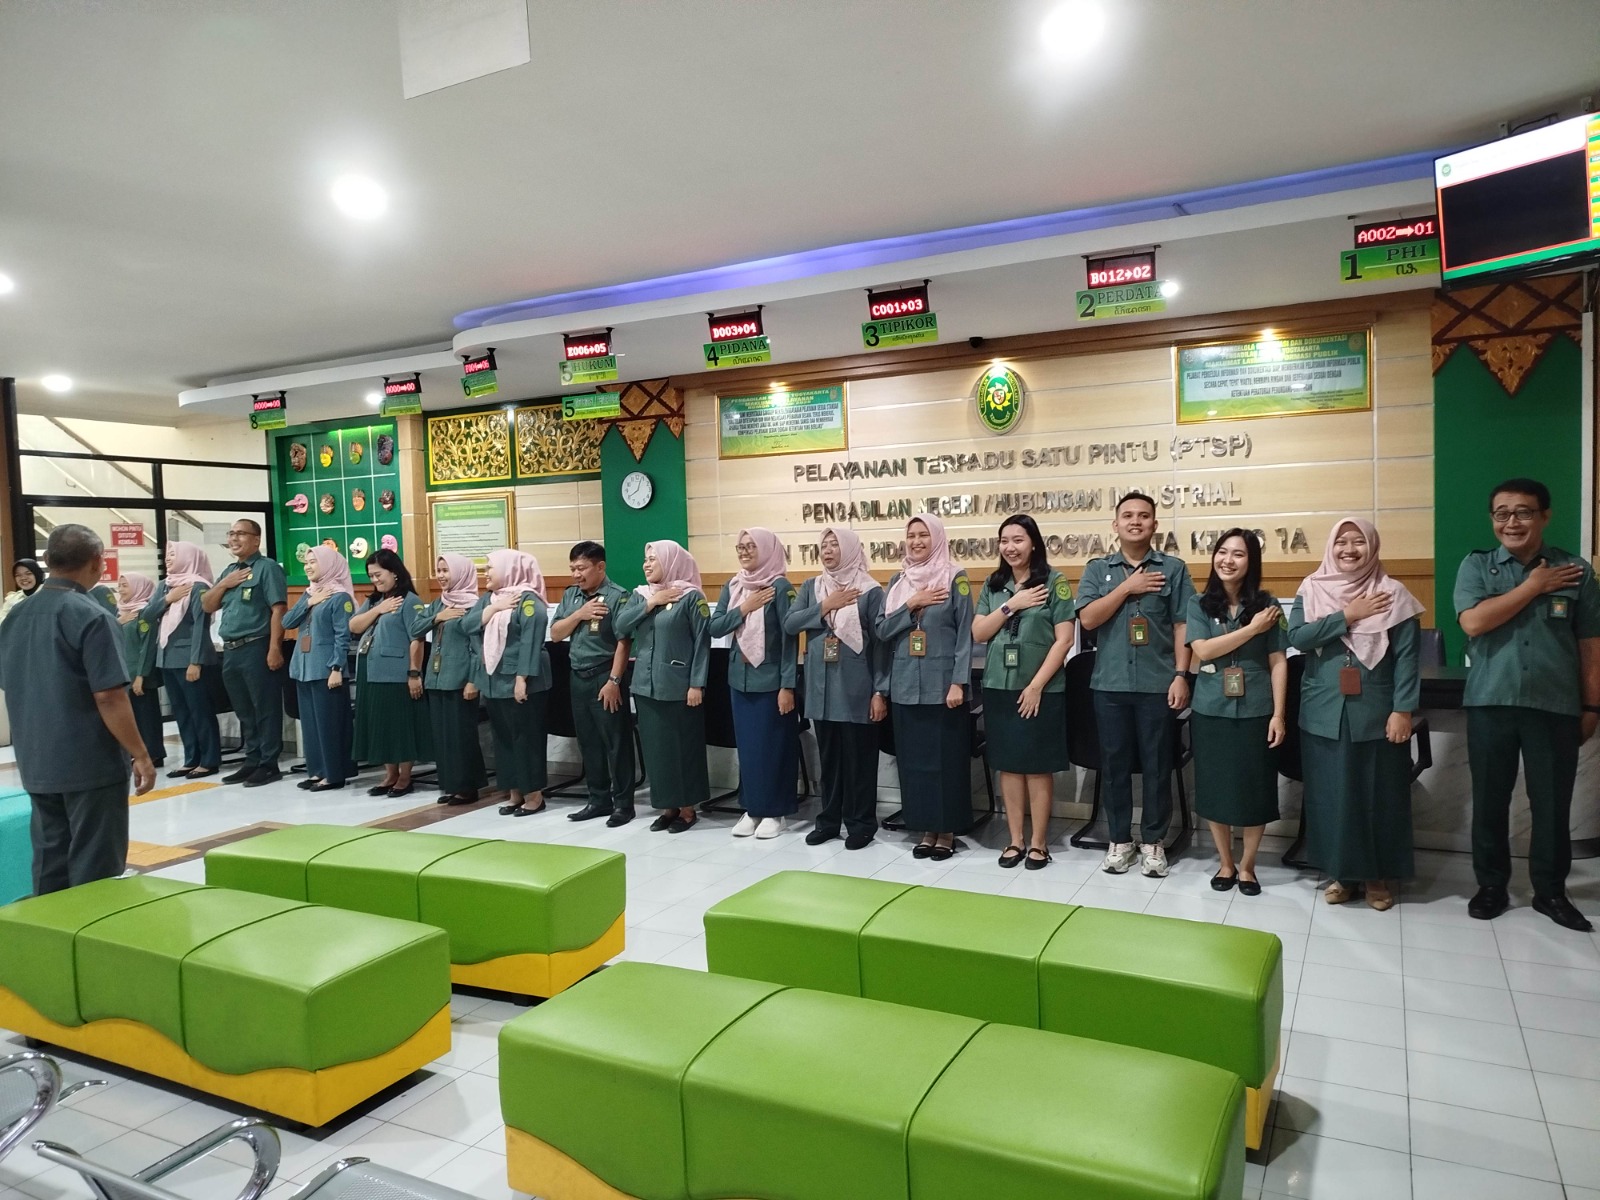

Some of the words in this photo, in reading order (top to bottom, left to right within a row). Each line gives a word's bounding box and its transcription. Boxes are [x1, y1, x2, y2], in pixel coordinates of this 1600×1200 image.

[1358, 227, 1396, 243] A002
[1414, 221, 1435, 236] 01
[1345, 253, 1362, 280] 1
[1386, 244, 1426, 261] PHI
[1090, 268, 1124, 284] B012
[1133, 265, 1151, 278] 02
[872, 302, 901, 316] C001
[907, 299, 923, 311] 03
[1079, 293, 1096, 318] 2
[1098, 285, 1163, 304] PERDATA
[712, 325, 738, 338] D003
[743, 322, 757, 334] 04
[865, 325, 880, 346] 3
[880, 316, 934, 334] TIPIKOR
[594, 343, 606, 353] 05
[707, 346, 719, 366] 4
[720, 340, 766, 355] PIDANA
[562, 364, 573, 382] 5
[573, 358, 614, 371] HUKUM
[464, 380, 470, 396] 6
[564, 400, 575, 417] 5
[251, 415, 258, 429] 8
[793, 458, 908, 483] PELAYANAN
[914, 449, 1015, 475] TERPADU
[1021, 444, 1081, 468] SATU
[1088, 439, 1158, 465] PINTU
[1169, 432, 1253, 461] (PTSP)
[802, 497, 912, 523] PENGADILAN
[870, 539, 906, 564] PIDA
